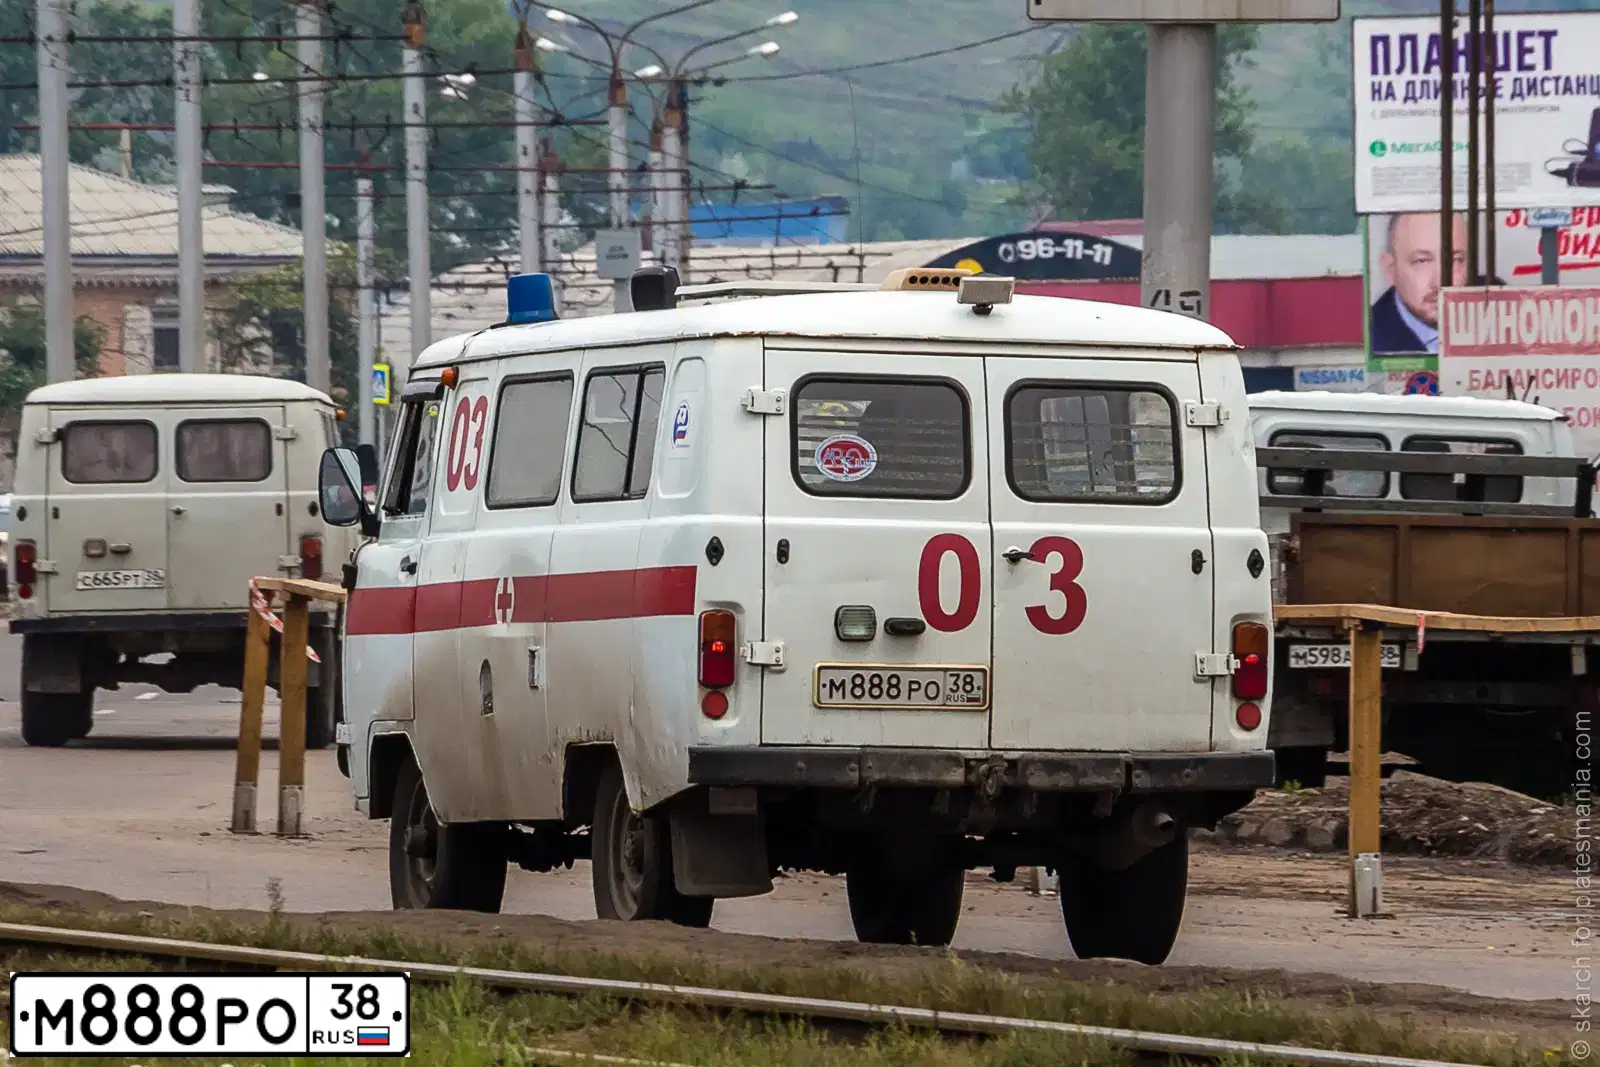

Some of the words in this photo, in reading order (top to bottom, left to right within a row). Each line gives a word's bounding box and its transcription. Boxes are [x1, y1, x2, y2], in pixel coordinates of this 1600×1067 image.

[1370, 30, 1558, 75] ПЛАНШЕТ
[1371, 80, 1396, 101] НА
[1448, 296, 1600, 346] ШИНОМОН
[1468, 367, 1600, 391] БАЛАНСИРО
[447, 395, 488, 492] 03
[828, 673, 940, 701] М888РО
[948, 673, 975, 694] 38
[946, 694, 966, 703] RUS
